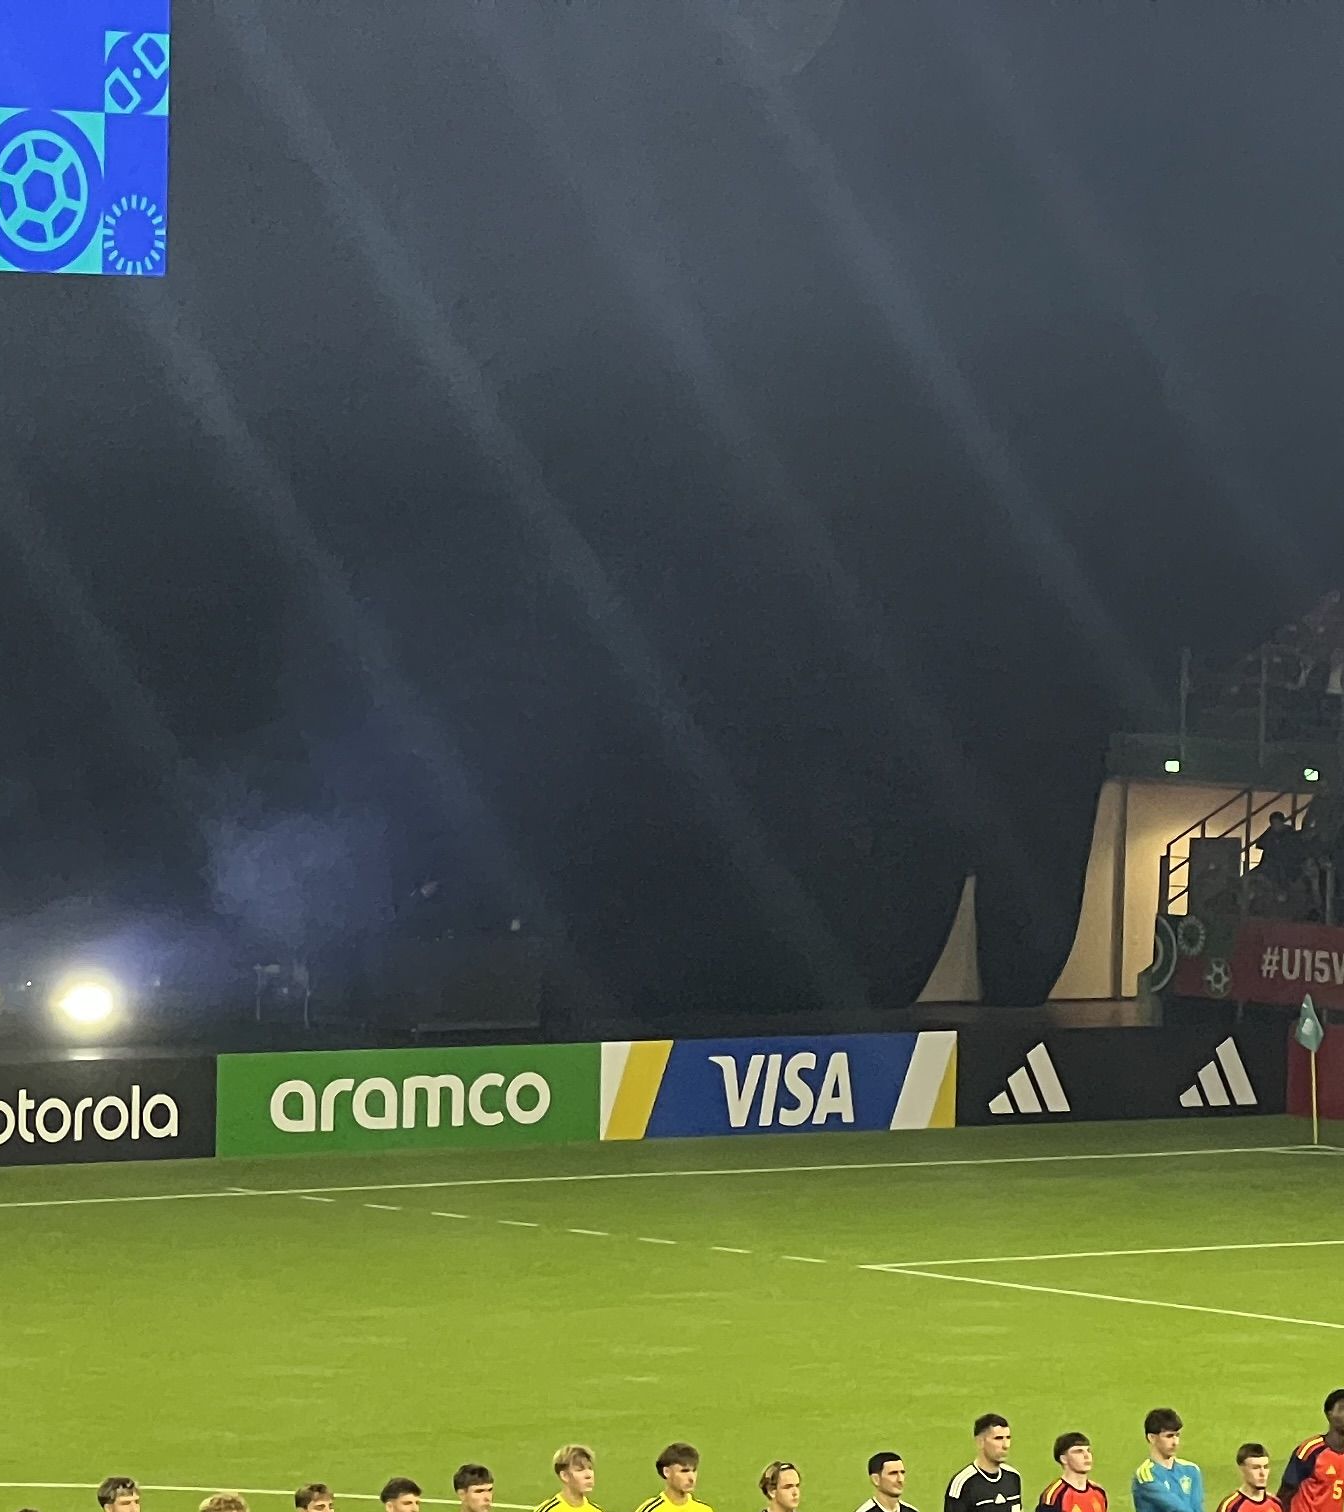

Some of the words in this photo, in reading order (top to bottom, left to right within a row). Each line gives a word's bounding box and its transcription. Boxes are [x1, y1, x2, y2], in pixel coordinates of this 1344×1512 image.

[268, 1070, 551, 1133] aramco
[708, 1051, 855, 1128] VISA
[1332, 1479, 1343, 1500] 5
